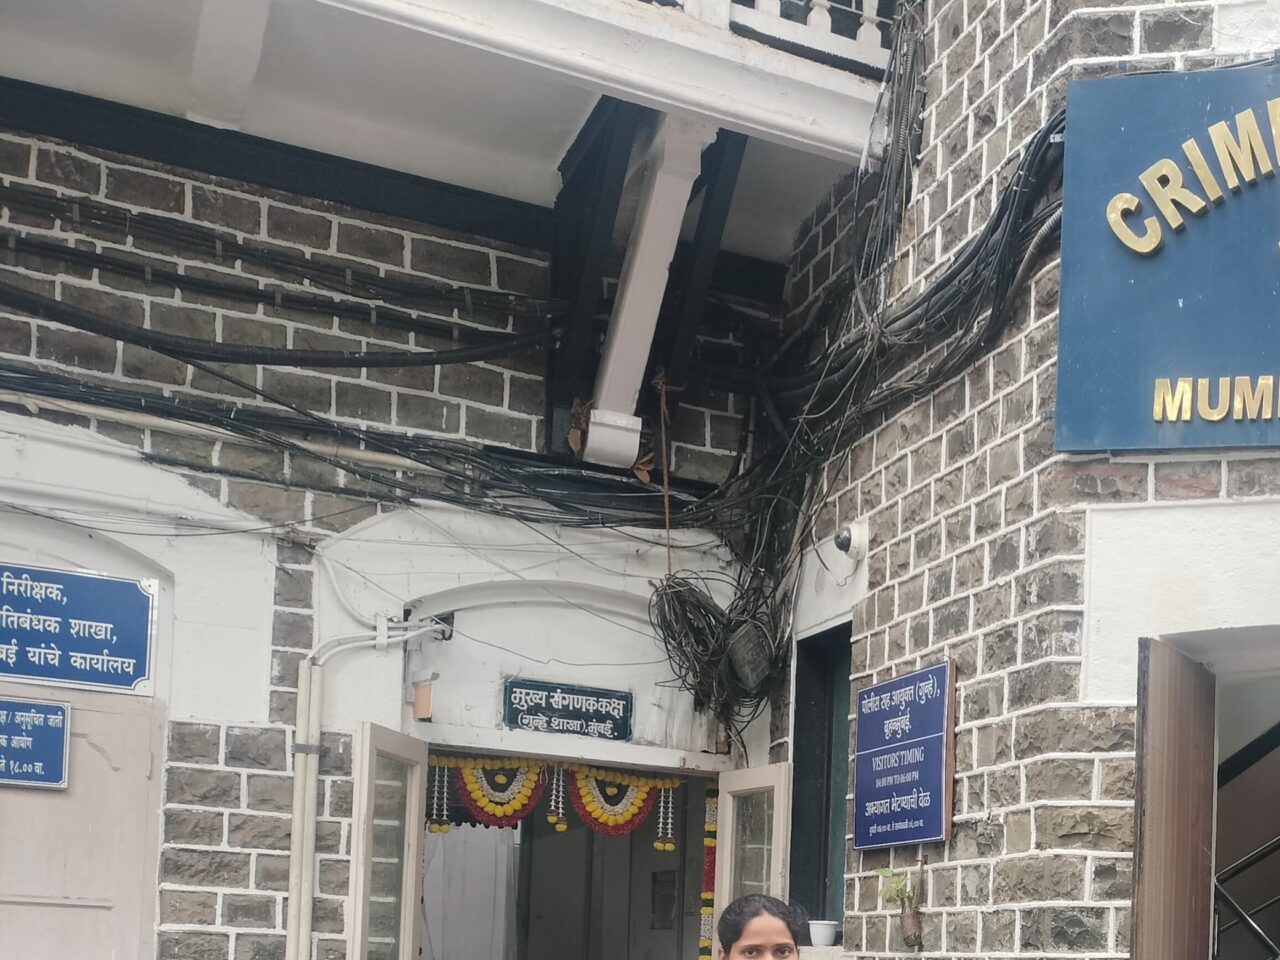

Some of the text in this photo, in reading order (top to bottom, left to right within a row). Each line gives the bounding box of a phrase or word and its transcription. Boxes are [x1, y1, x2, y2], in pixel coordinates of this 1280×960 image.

[1, 571, 67, 605] निरीक्षक,
[0, 605, 117, 644] तिबंधक शाखा,
[26, 643, 62, 667] यांचे
[69, 649, 136, 675] कार्यालय
[511, 688, 548, 711] मुख्य
[862, 692, 880, 714] पोलीस
[891, 686, 914, 709] आयुक्त
[15, 709, 45, 730] अनुसूचित
[11, 732, 33, 749] आयोग
[872, 746, 924, 771] VISITORS TIMING
